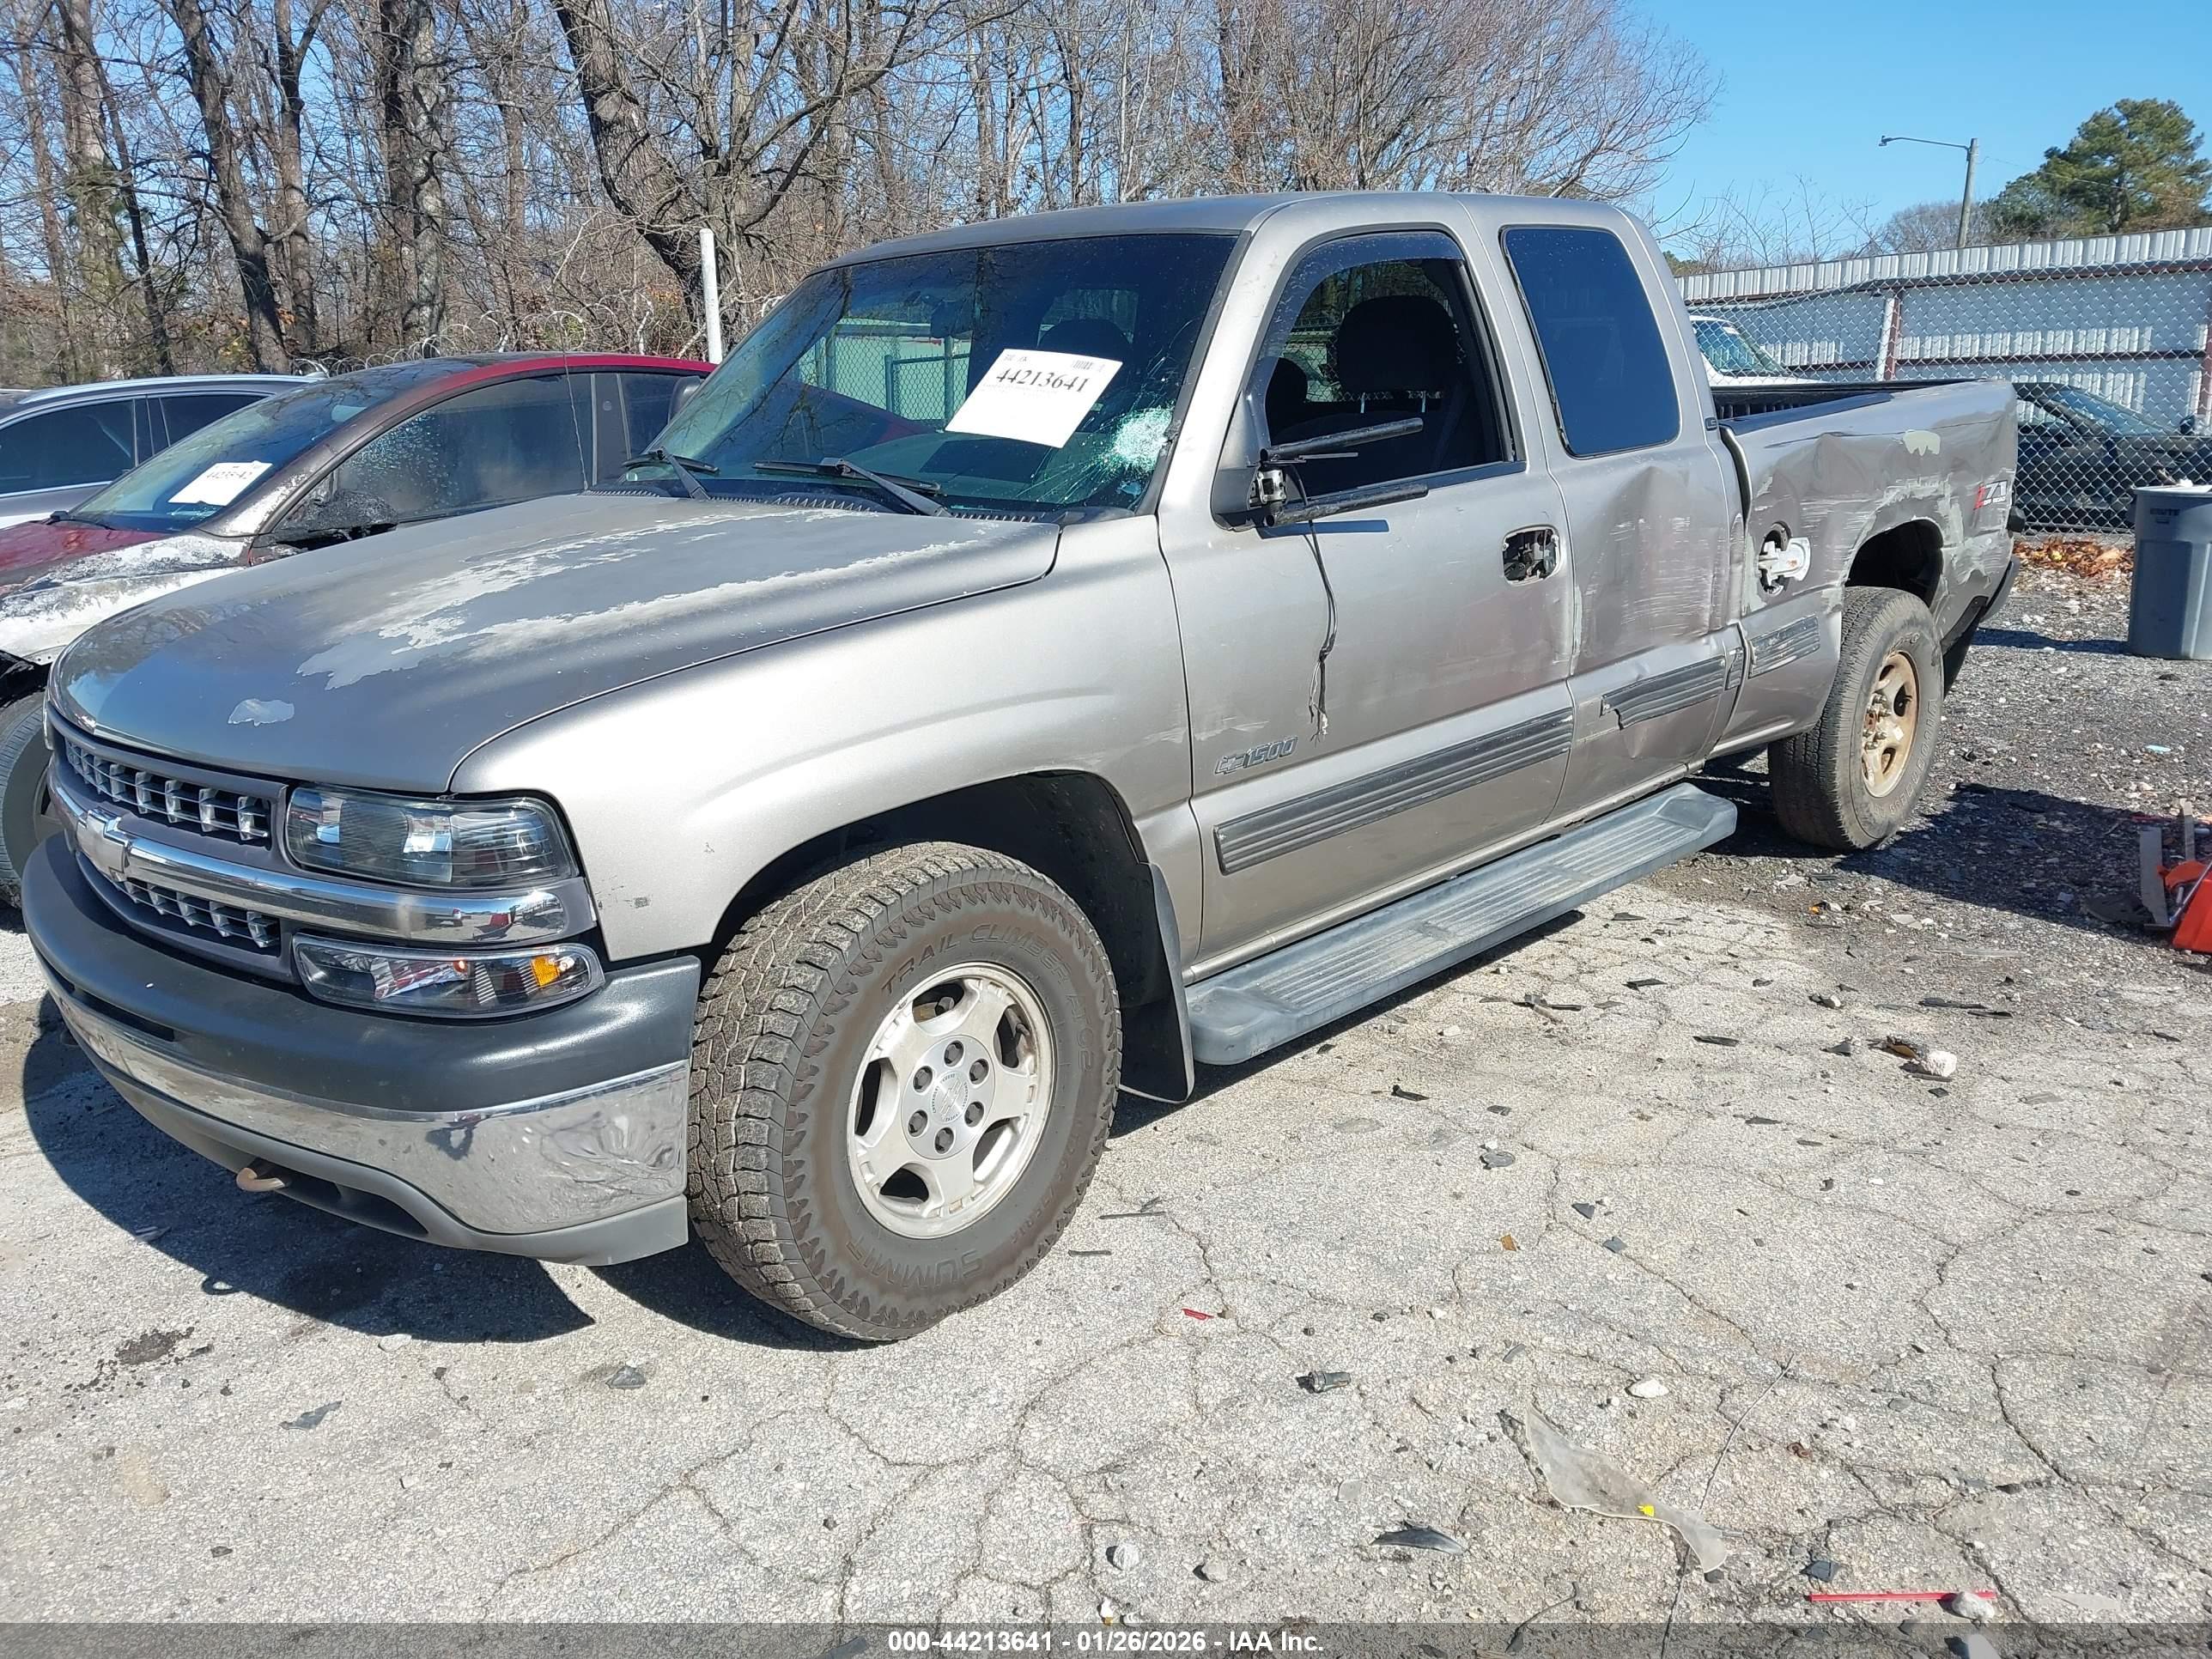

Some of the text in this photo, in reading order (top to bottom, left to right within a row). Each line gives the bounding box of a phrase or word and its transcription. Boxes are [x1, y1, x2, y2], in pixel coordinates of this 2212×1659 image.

[996, 368, 1091, 392] 44213641
[1973, 480, 2008, 511] Z71
[1243, 736, 1298, 769] 1500
[880, 933, 961, 994] TRAIL
[969, 923, 1073, 984] CLIMBER
[845, 1236, 983, 1288] SUMMIT
